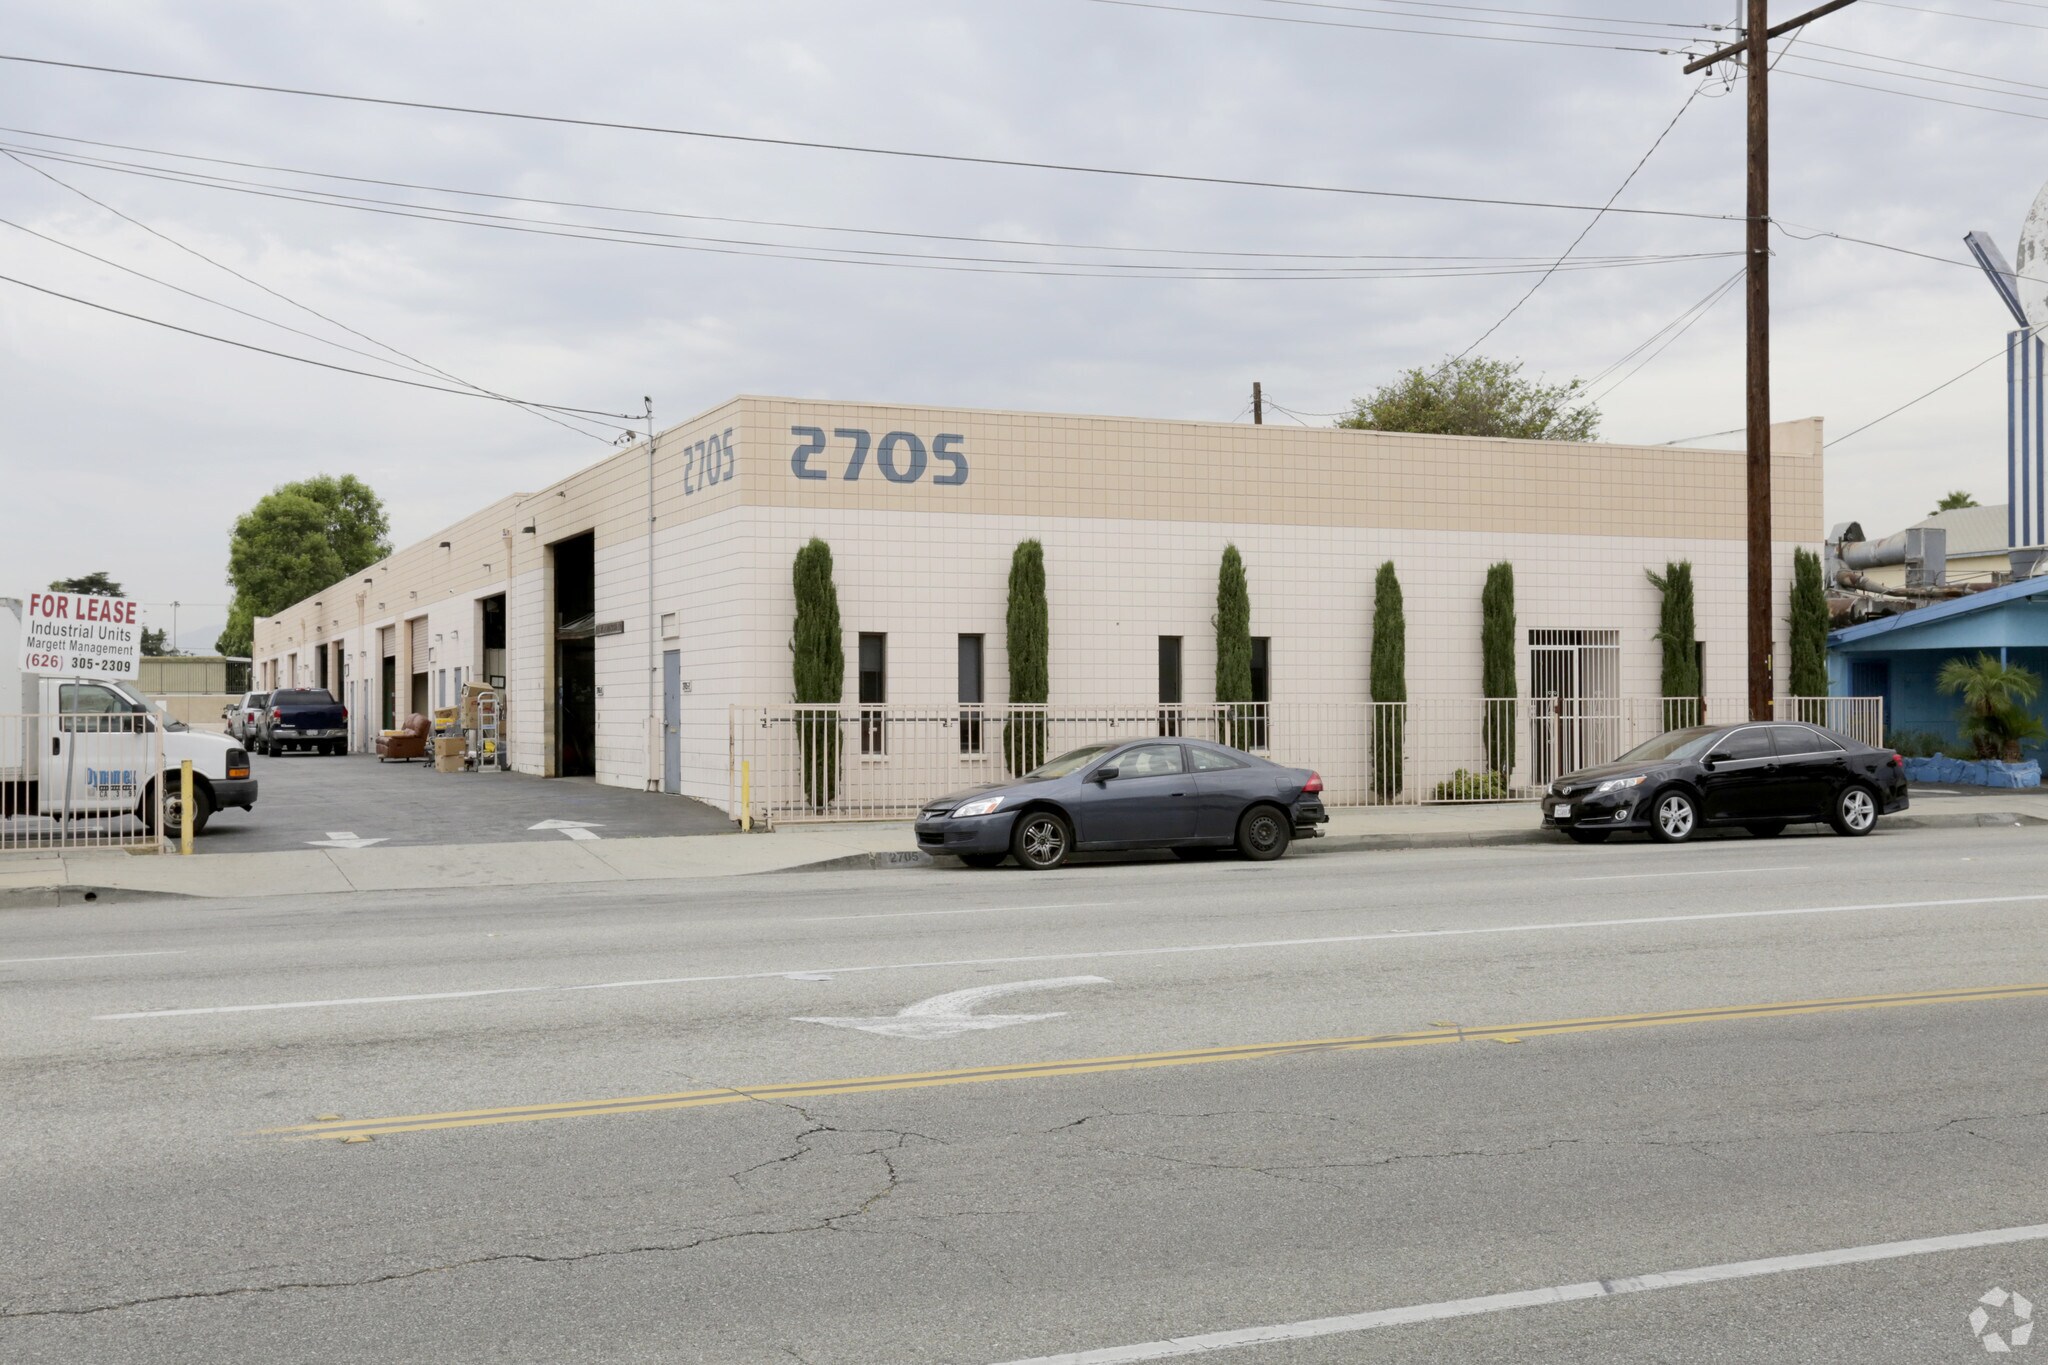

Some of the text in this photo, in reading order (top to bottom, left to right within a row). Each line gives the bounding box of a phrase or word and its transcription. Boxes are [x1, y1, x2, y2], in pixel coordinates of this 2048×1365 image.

[683, 427, 735, 496] 2705
[790, 425, 969, 486] 2705
[29, 593, 137, 625] FOR LEASE
[31, 620, 131, 642] Industrial Units
[26, 636, 133, 656] Margett Management
[25, 653, 131, 672] (626) 305-2309
[889, 851, 919, 863] 2705
